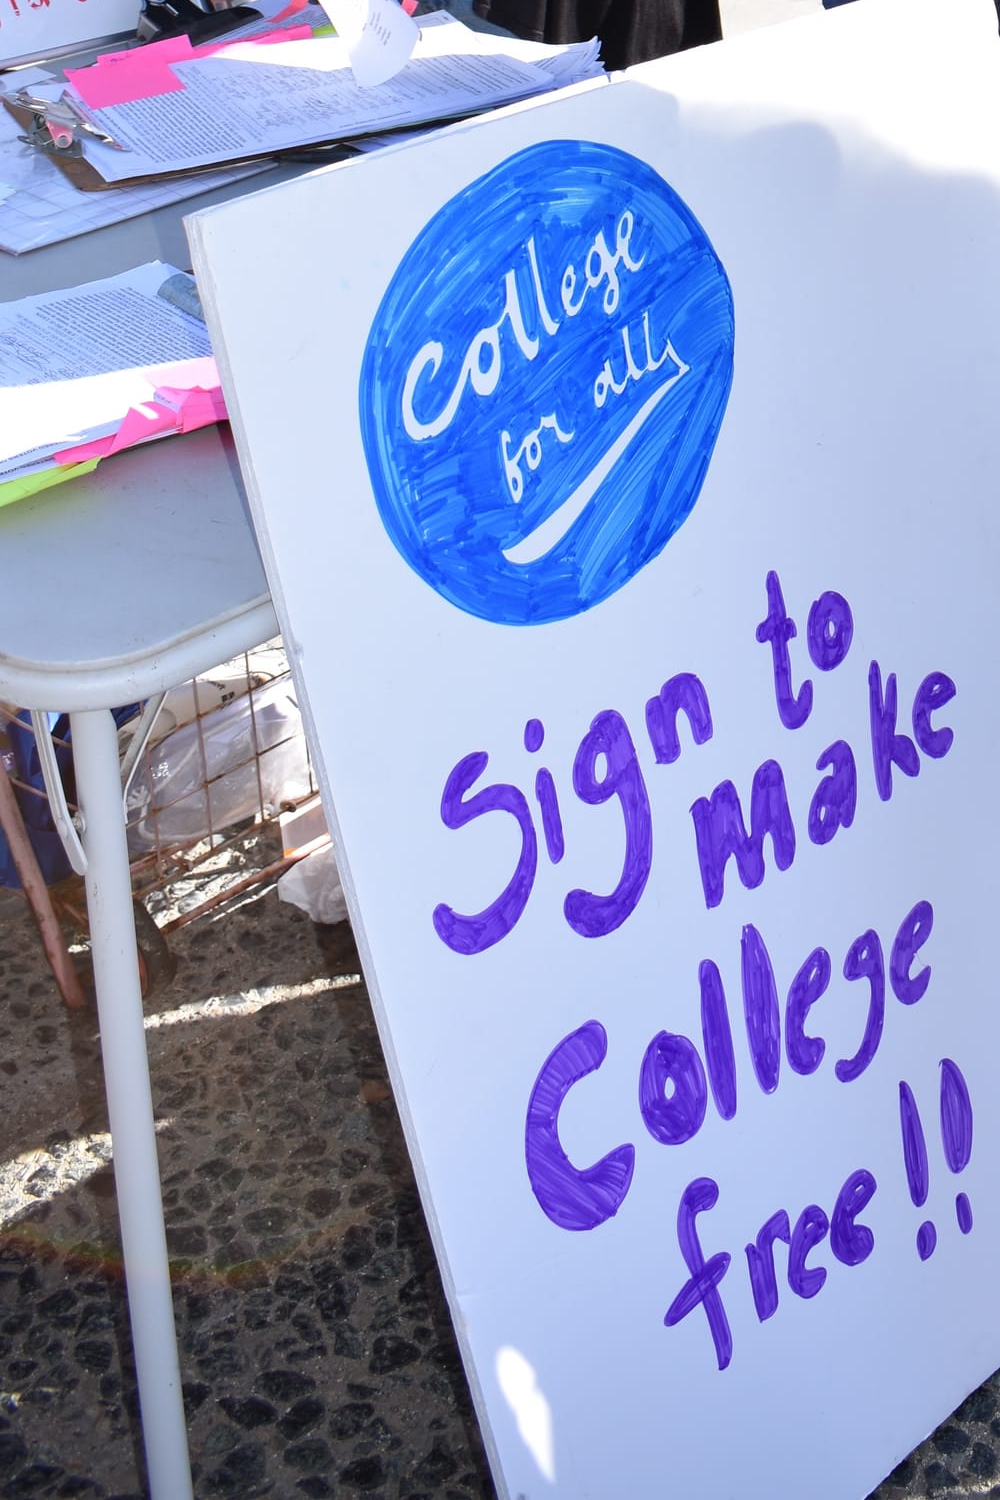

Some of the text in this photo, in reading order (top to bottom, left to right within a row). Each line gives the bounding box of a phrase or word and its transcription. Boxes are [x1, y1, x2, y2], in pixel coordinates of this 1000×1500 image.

[402, 210, 646, 441] College
[501, 414, 575, 504] for
[432, 672, 714, 956] Sign
[755, 569, 854, 731] to
[688, 659, 957, 911] make
[524, 899, 934, 1232] College
[662, 1057, 974, 1371] free!!
